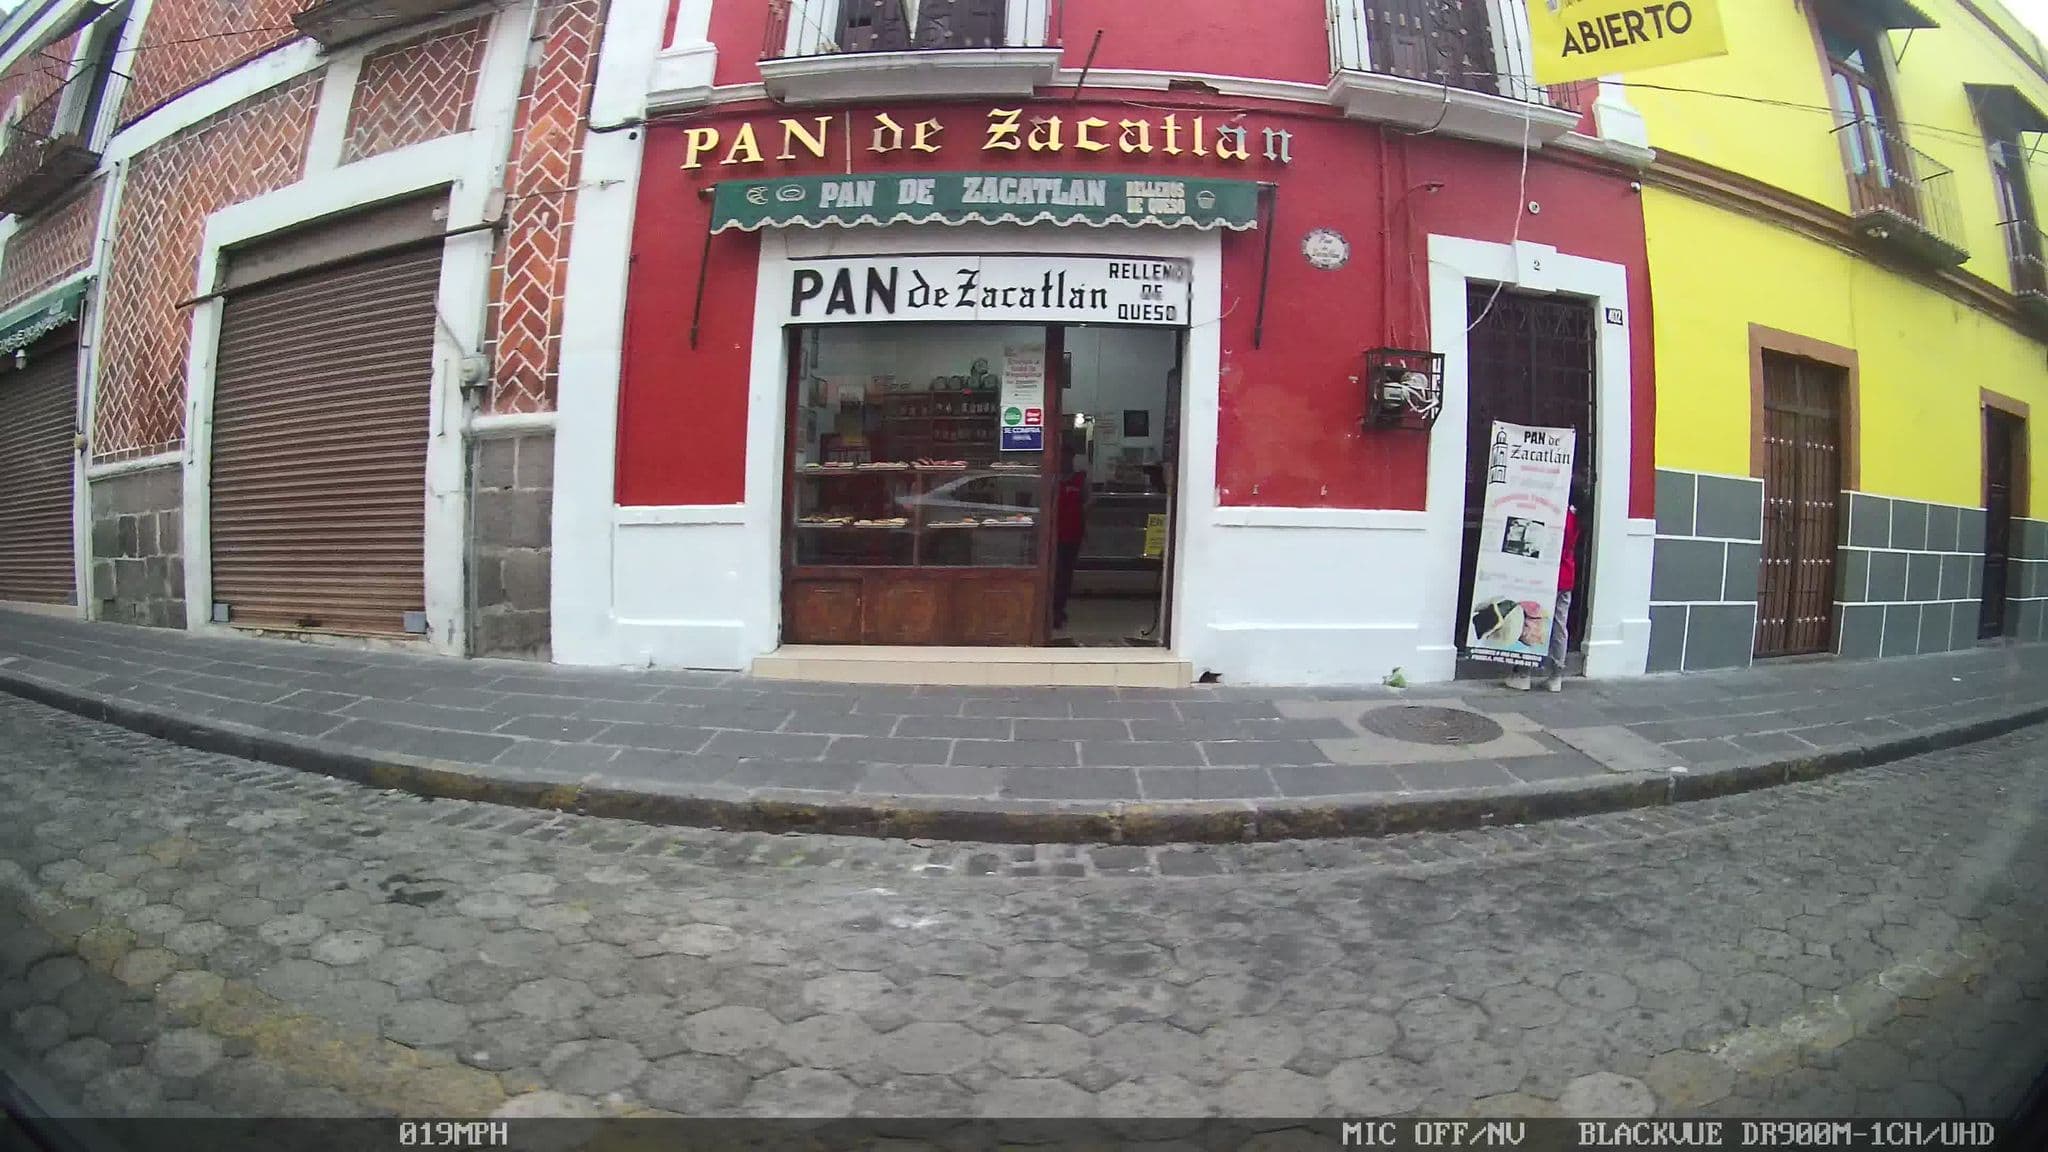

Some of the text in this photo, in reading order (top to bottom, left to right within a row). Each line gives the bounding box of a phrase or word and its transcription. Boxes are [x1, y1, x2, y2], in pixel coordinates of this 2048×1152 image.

[1562, 1, 1692, 57] ABIERTO
[680, 108, 1293, 170] PAN de Zacatlán
[819, 177, 1106, 208] PAN DE ZACATLAN
[1533, 259, 1541, 271] 2
[791, 266, 898, 317] PAN
[1118, 303, 1177, 321] QUESO
[1524, 431, 1561, 446] PAN de
[1510, 444, 1571, 465] Zacatlán
